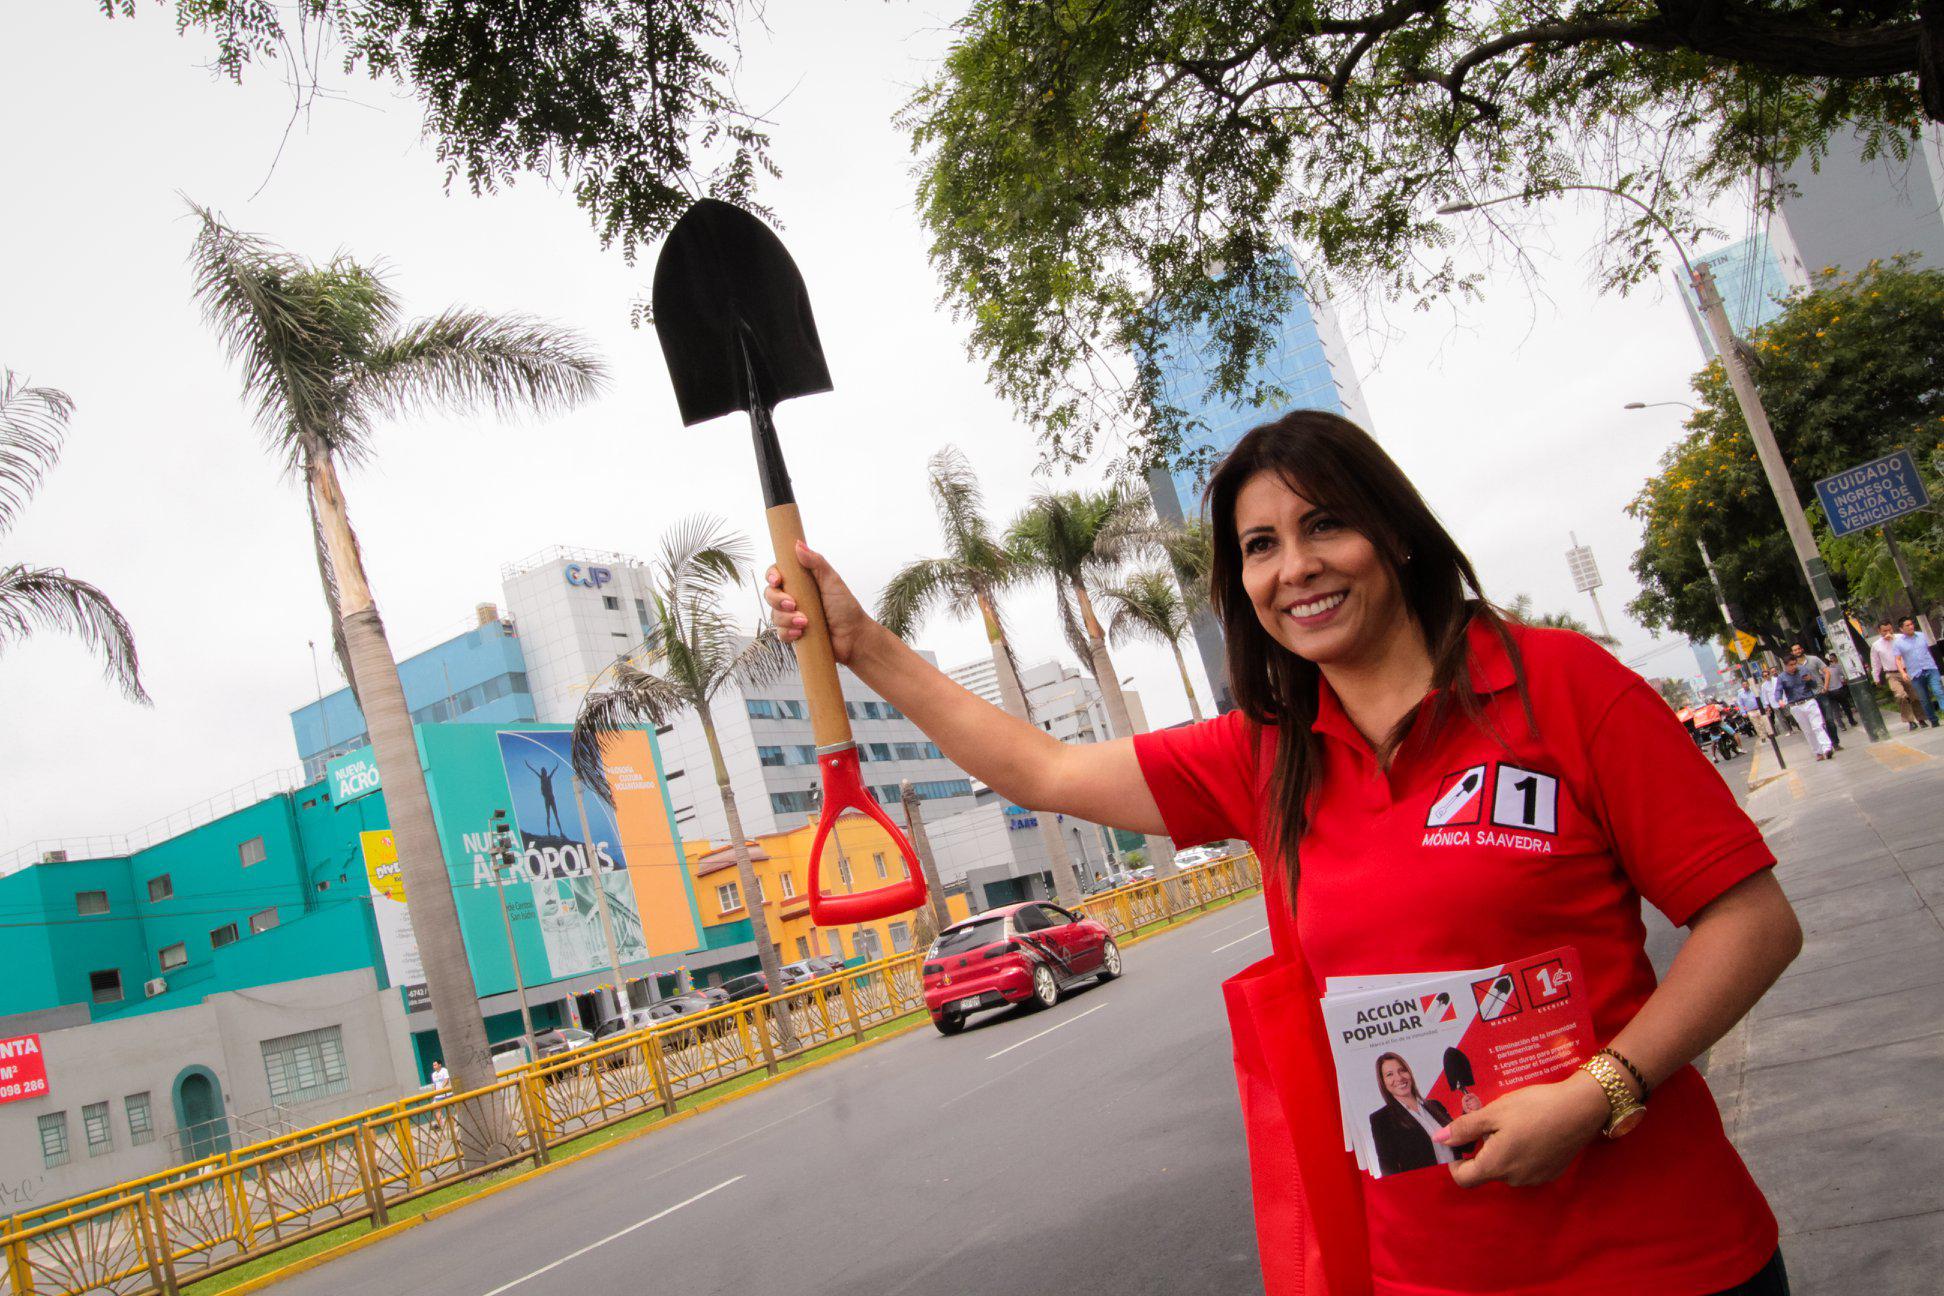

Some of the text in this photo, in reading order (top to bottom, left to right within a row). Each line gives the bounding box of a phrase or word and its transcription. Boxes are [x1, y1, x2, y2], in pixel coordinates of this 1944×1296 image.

[1827, 458, 1901, 494] CUIDADO
[1834, 473, 1905, 507] INGRESO Y
[1838, 485, 1911, 518] SALIDA DE
[1842, 496, 1917, 530] VEHICULOS
[335, 761, 367, 781] NUEVA
[1513, 776, 1537, 826] 1
[1422, 828, 1551, 853] MÓNICA SAAVEDRA
[1536, 968, 1557, 997] 1
[1357, 998, 1417, 1024] ACCIÓN
[1343, 1015, 1423, 1044] POPULAR
[0, 1038, 39, 1059] NTA
[0, 1078, 45, 1098] 098 286
[1505, 1075, 1524, 1085] Lucha
[1524, 1069, 1544, 1080] contra
